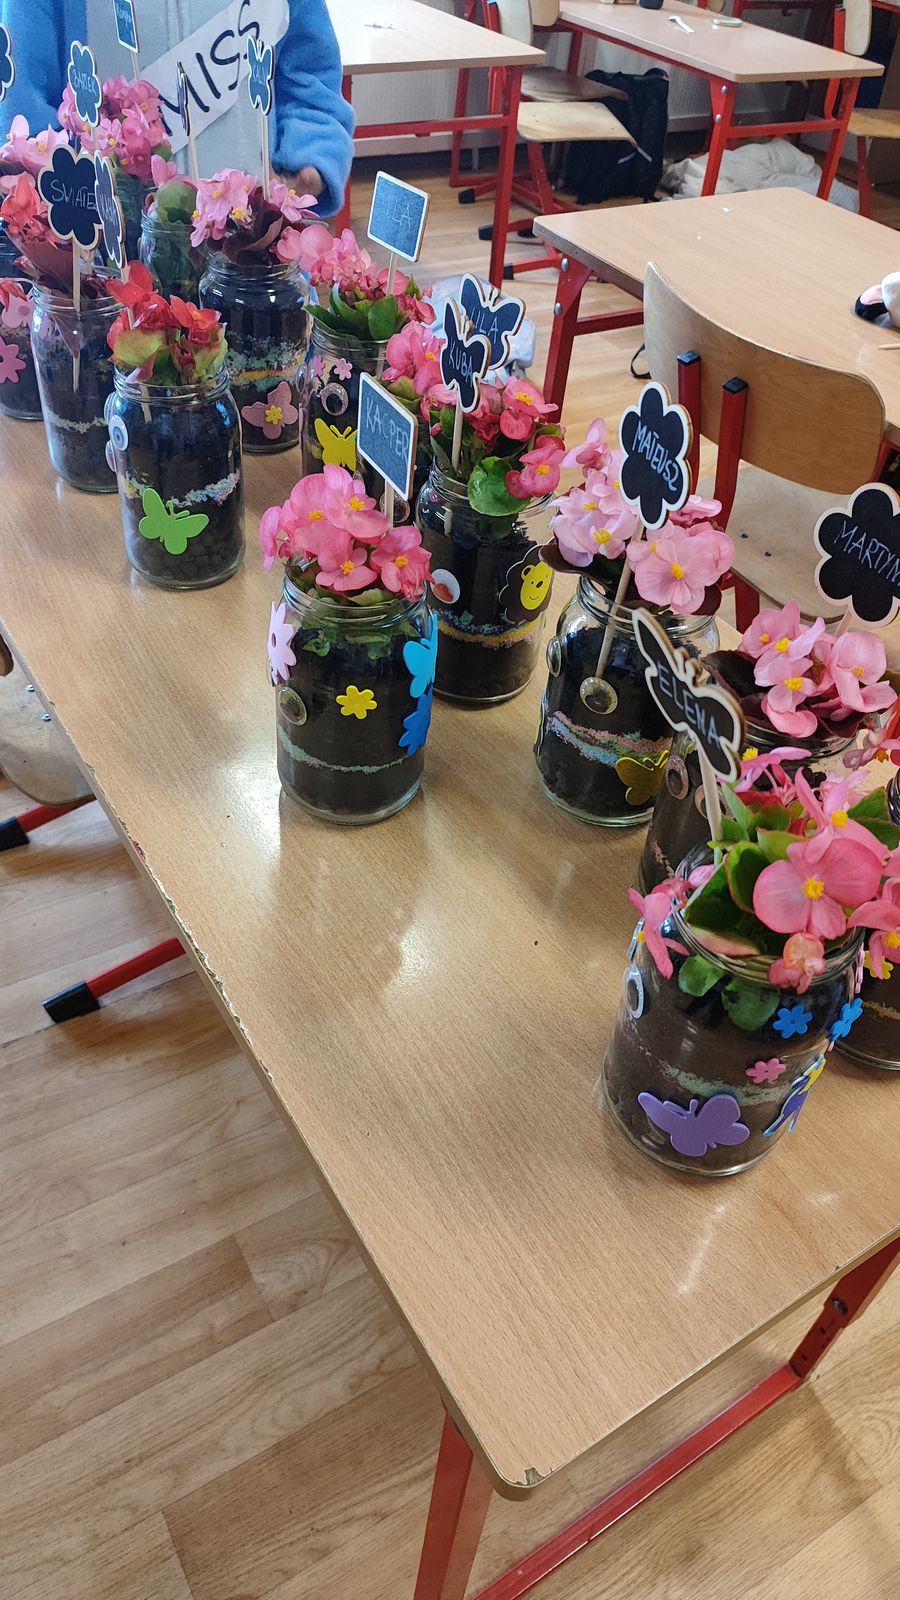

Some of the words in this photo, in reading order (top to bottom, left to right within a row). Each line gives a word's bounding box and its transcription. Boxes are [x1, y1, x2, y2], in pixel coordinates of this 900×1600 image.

[448, 338, 474, 388] KUBA
[366, 397, 409, 468] KACPER
[632, 420, 679, 492] MATEUSZ
[833, 520, 900, 588] MARTYN
[656, 660, 720, 746] ELENA
